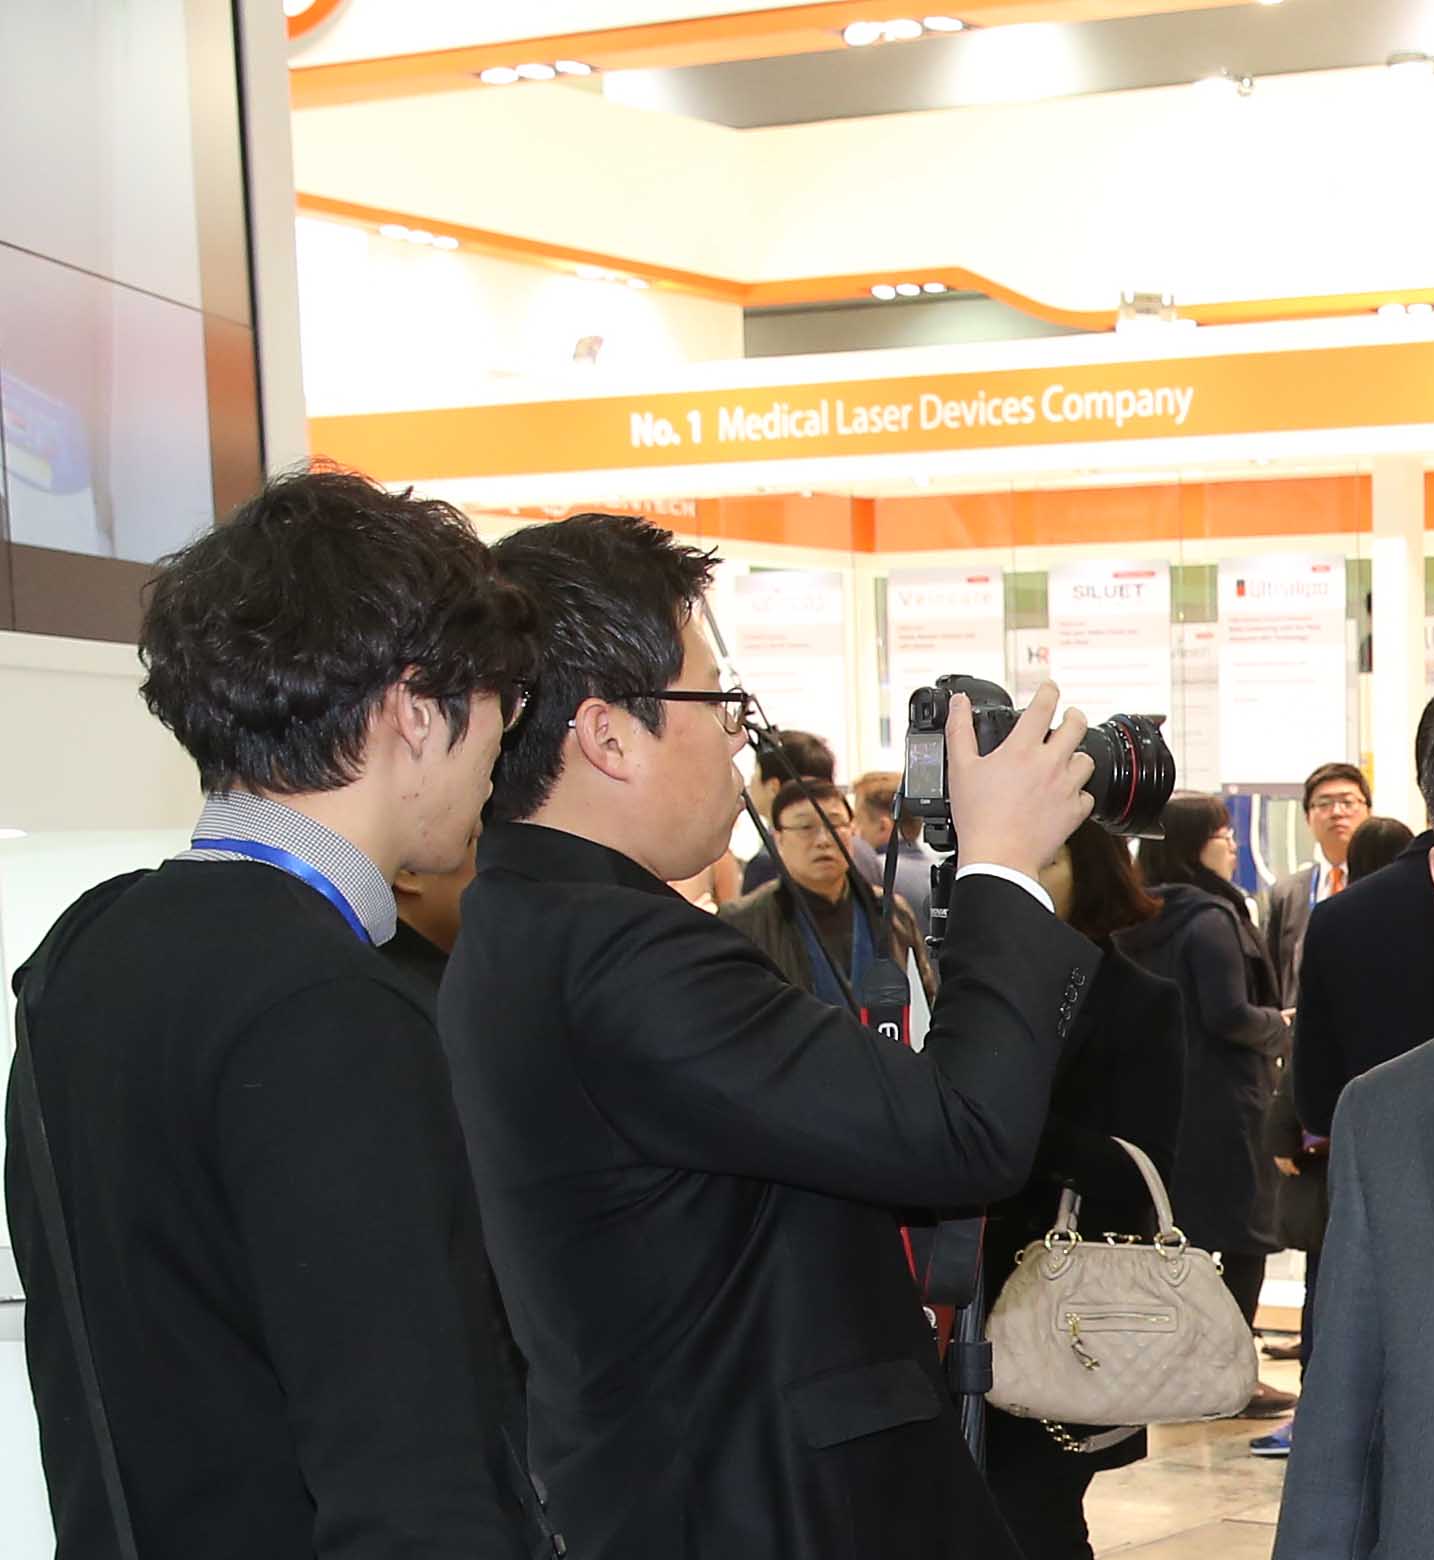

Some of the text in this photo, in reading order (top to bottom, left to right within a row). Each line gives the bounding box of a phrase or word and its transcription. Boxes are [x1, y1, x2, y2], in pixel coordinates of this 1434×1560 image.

[630, 384, 1194, 447] No. 1 Medical Laser Devices Company
